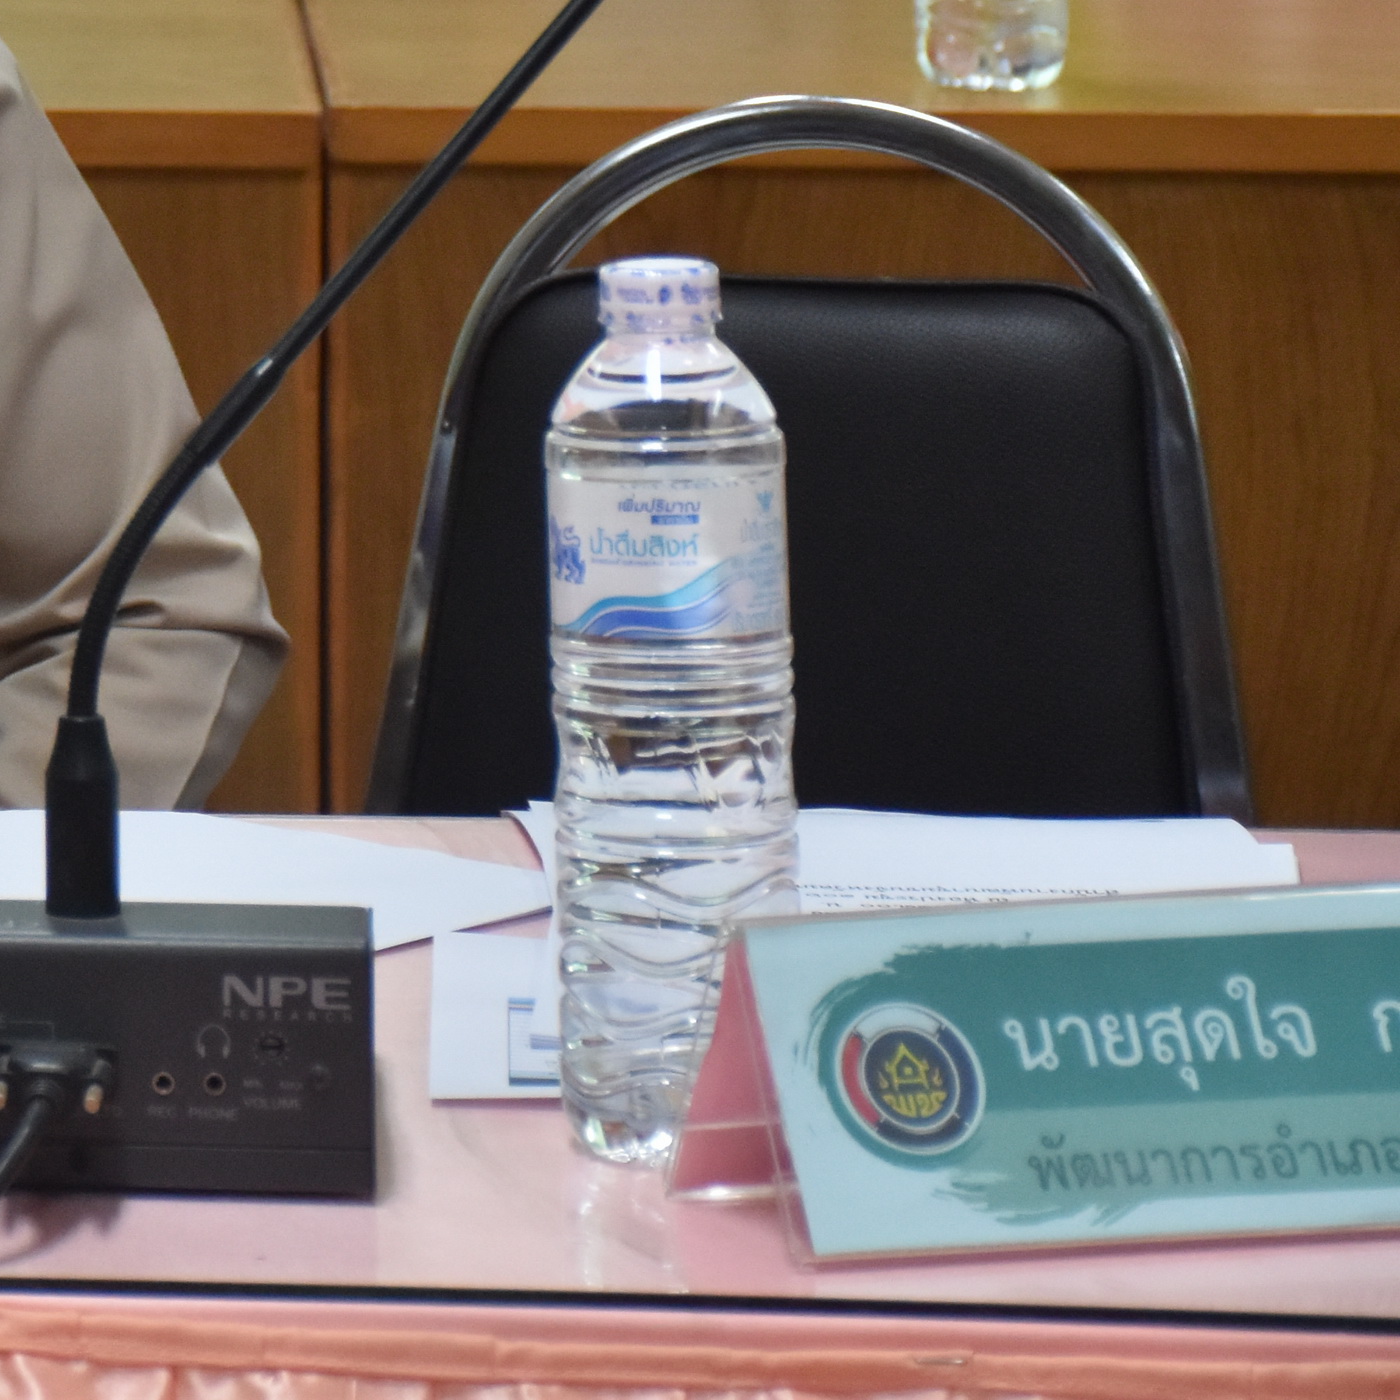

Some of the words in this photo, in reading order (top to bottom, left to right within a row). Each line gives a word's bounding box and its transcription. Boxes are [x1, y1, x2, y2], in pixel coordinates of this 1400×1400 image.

[220, 973, 353, 1011] NPE
[221, 1008, 355, 1024] RESEARCH
[1002, 975, 1319, 1092] นายสุดใจ
